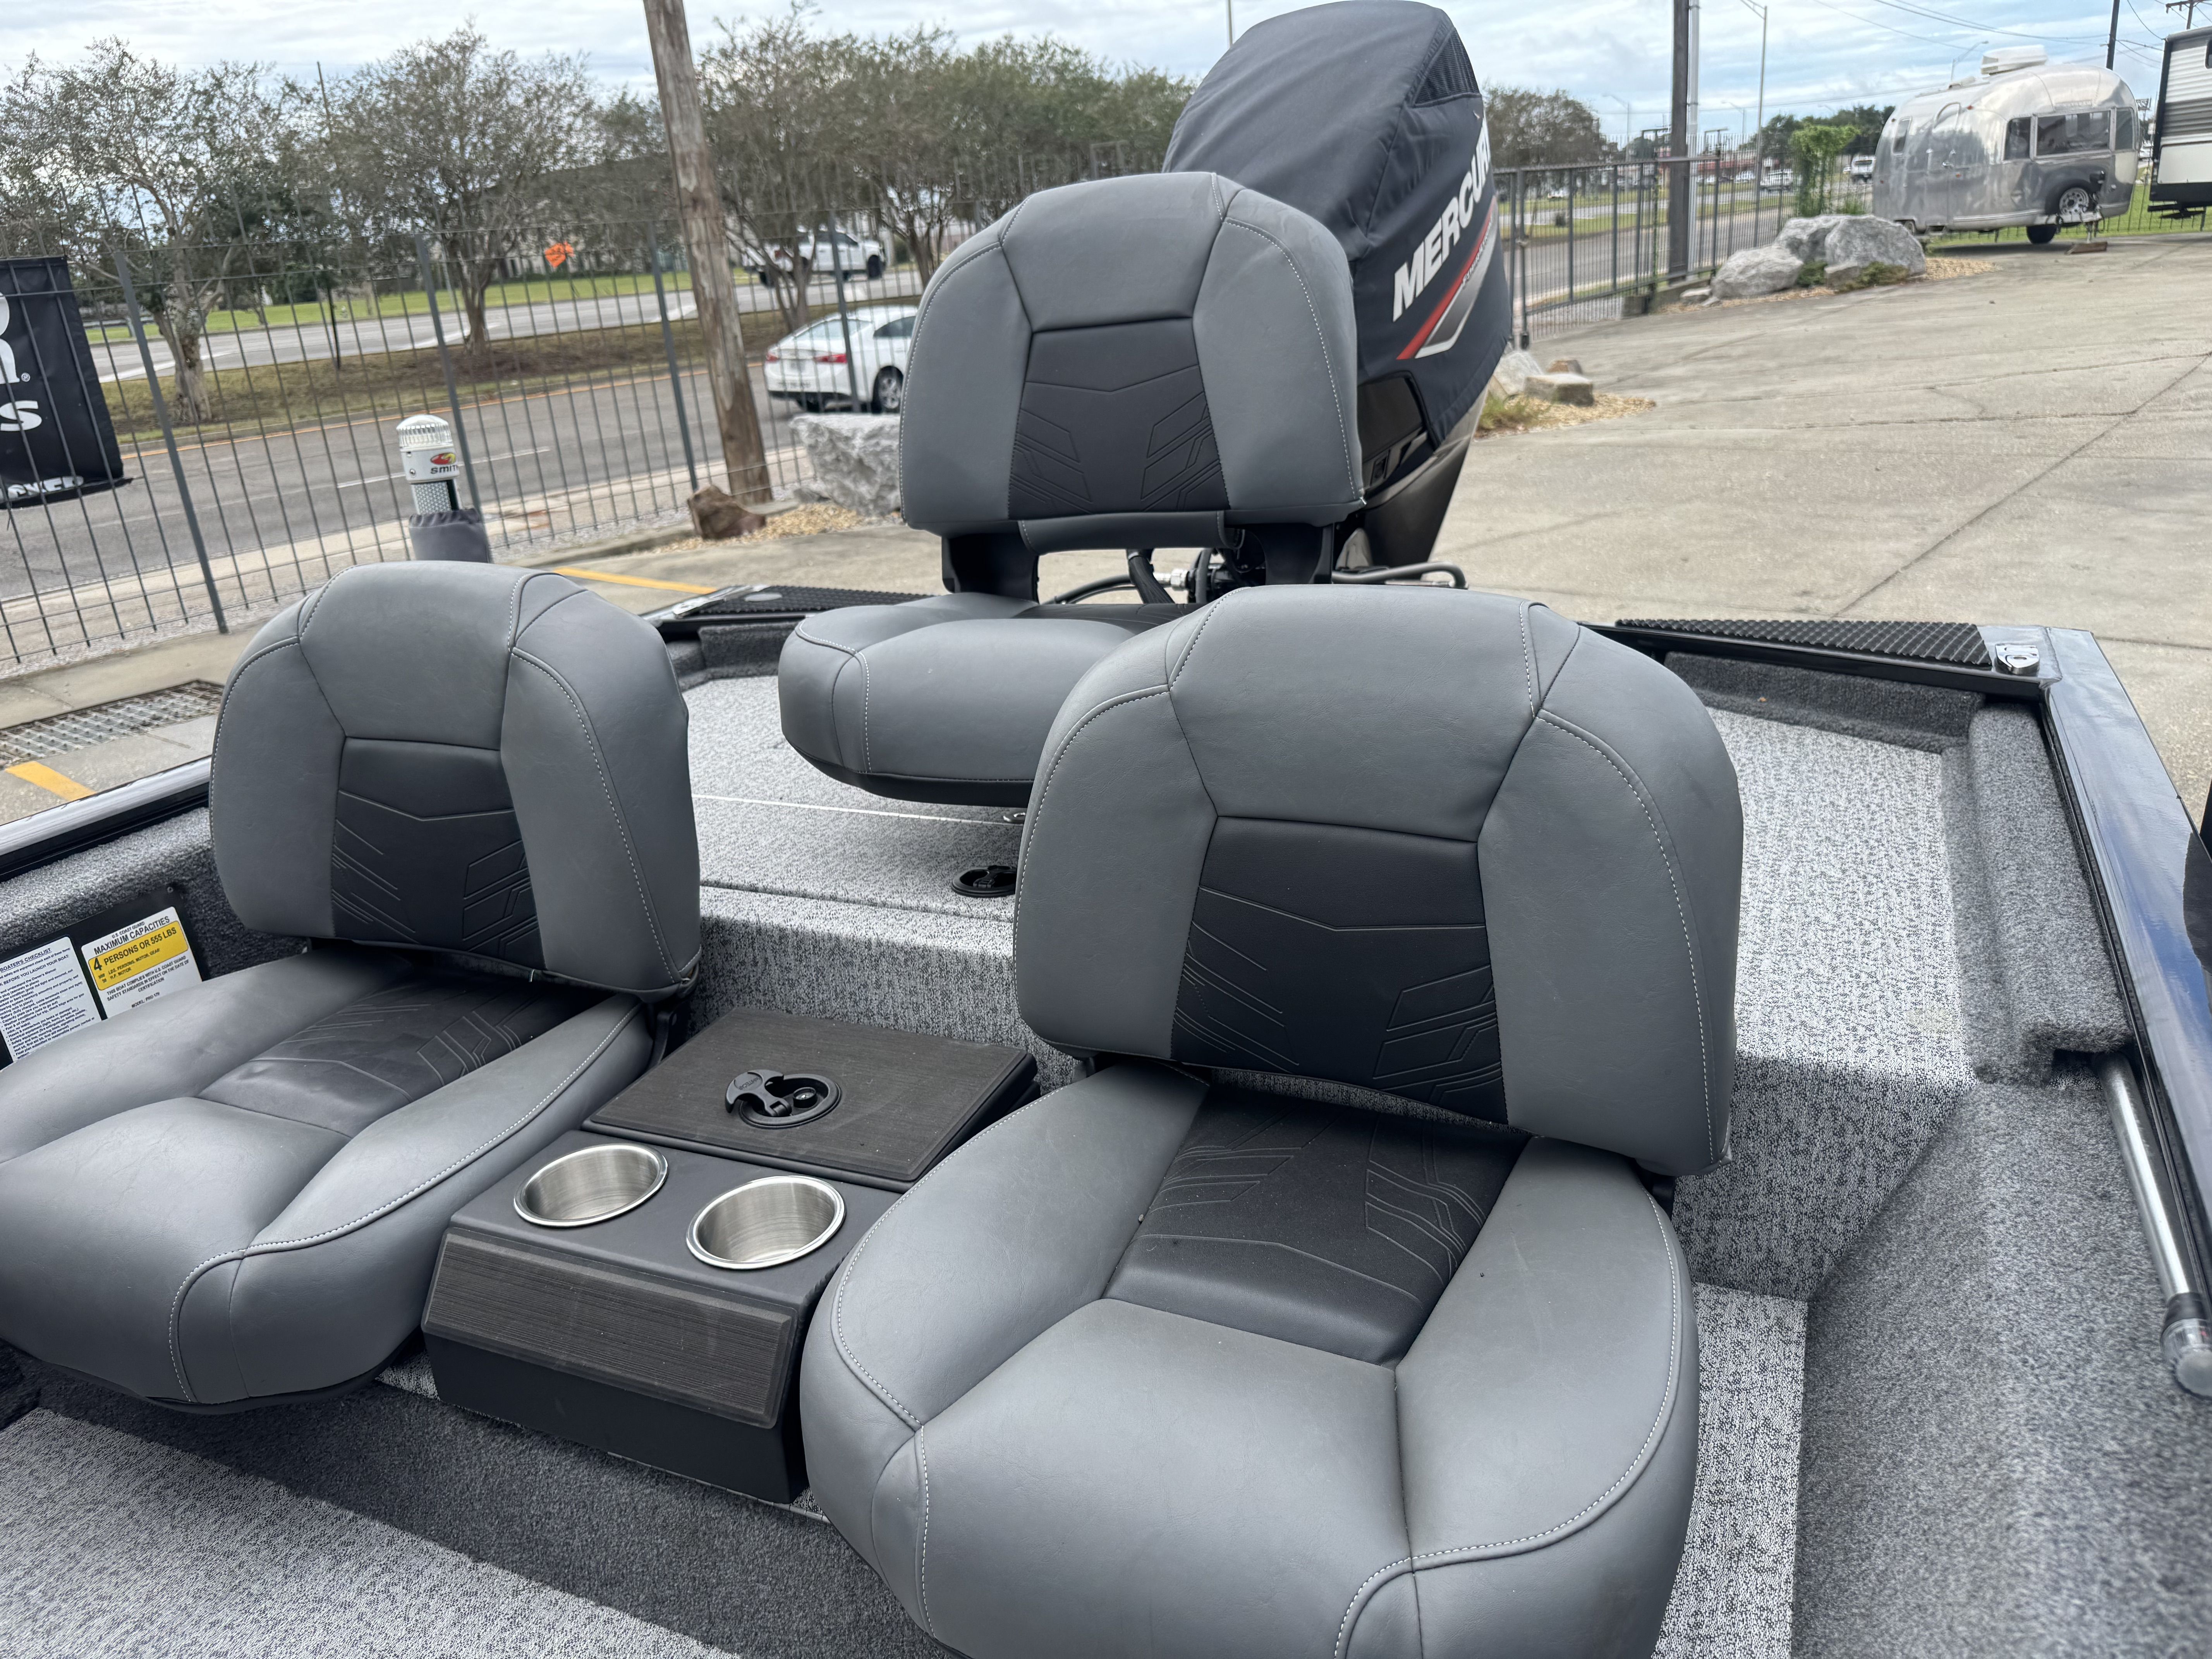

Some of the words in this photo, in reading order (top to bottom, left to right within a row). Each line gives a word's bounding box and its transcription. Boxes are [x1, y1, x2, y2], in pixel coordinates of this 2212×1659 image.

[1393, 106, 1491, 322] MERCUR
[94, 934, 129, 954] MAXIMUM
[130, 916, 169, 938] CAPACITIES
[119, 927, 131, 935] COAST
[104, 945, 138, 965] PERSONS
[139, 939, 150, 949] OR
[151, 934, 162, 944] 555
[162, 927, 177, 938] LBS
[0, 960, 24, 972] BOATER'S
[24, 948, 50, 961] CHECKLIST
[94, 957, 102, 970] 4
[3, 975, 20, 984] BEFORE
[29, 964, 46, 974] LAUNCH
[127, 975, 145, 986] COMPLIES
[161, 961, 173, 969] COAST
[107, 992, 121, 1001] SAFETY
[122, 981, 144, 994] STANDARDS
[148, 972, 161, 982] EFFECT
